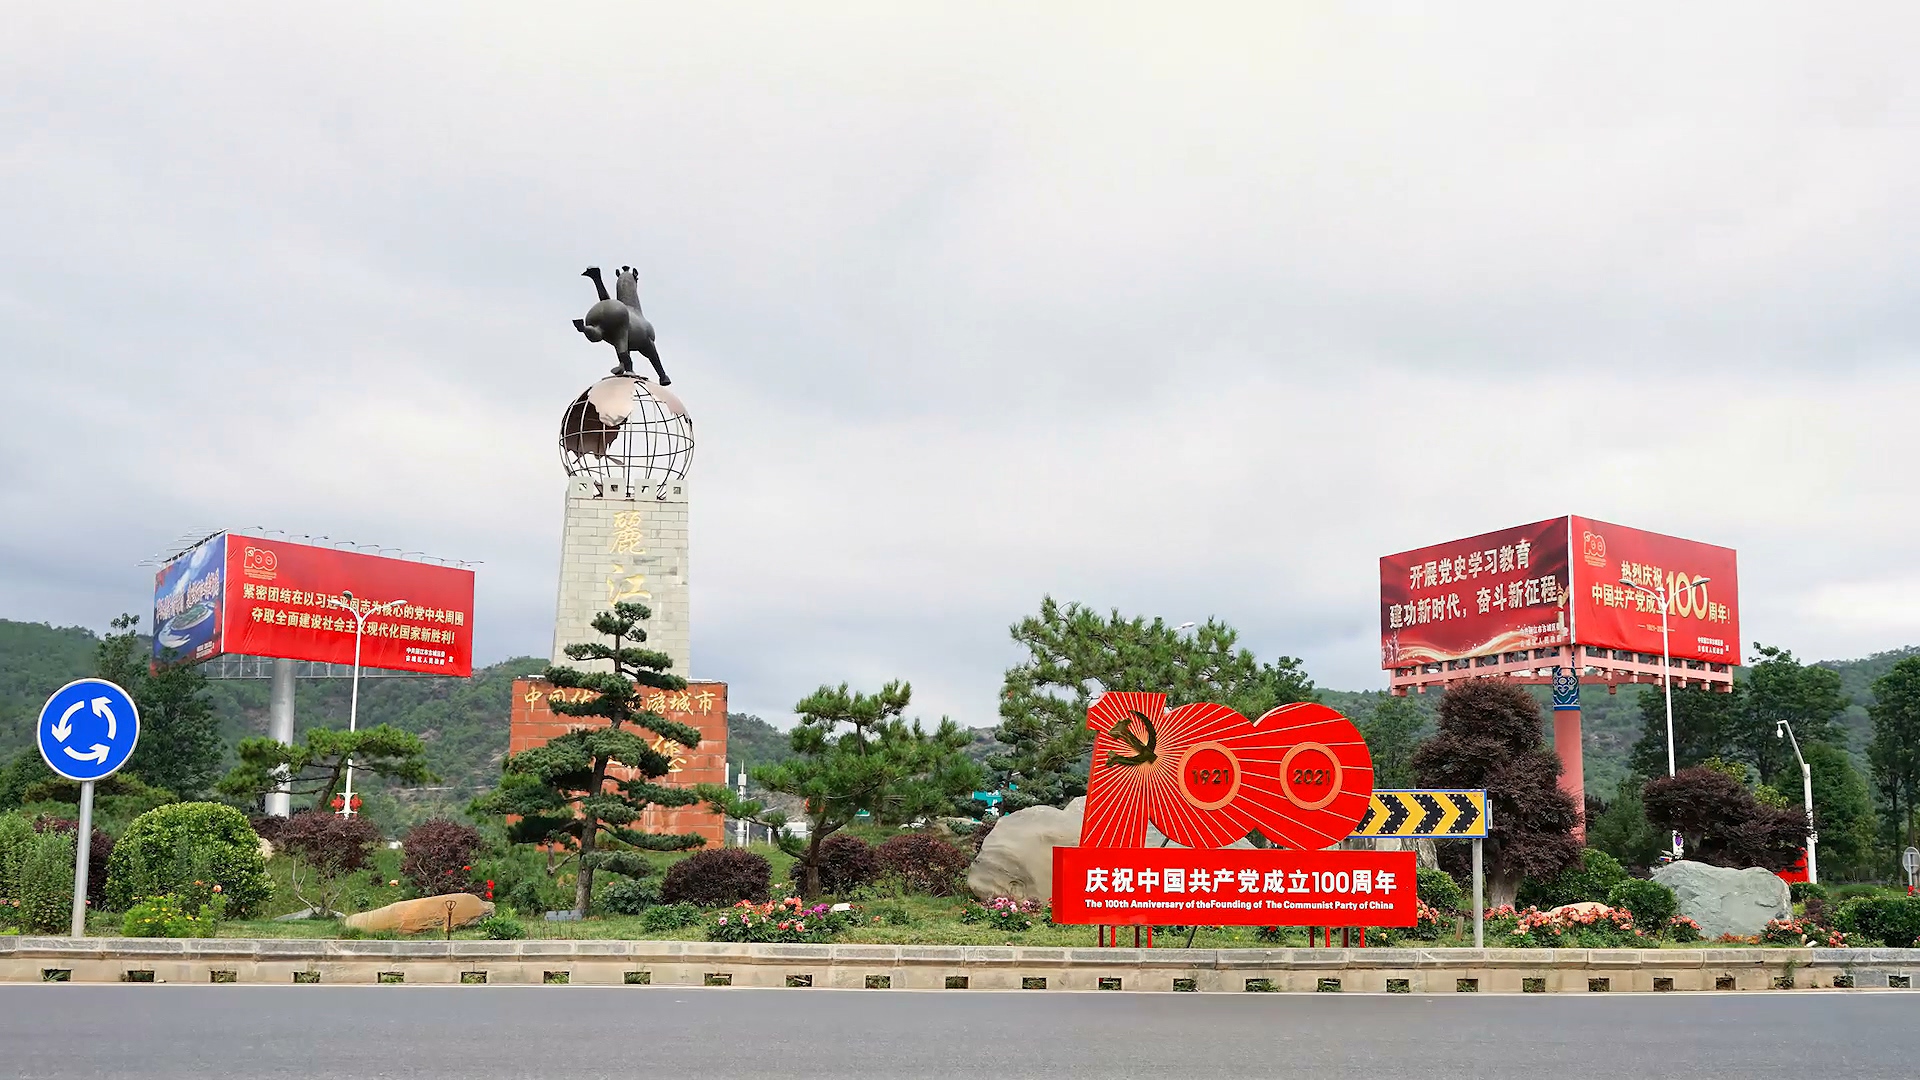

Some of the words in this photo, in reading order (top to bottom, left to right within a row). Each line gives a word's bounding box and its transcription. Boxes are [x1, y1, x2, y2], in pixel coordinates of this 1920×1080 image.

[1409, 538, 1532, 591] 开展党史学习教育
[1621, 560, 1664, 588] 热烈庆祝
[242, 583, 464, 627] 紧密团结在以习近平同志为核心的党中央周围
[1389, 574, 1558, 629] 建功新时代，奋斗新征程
[1191, 769, 1229, 785] 1921
[1293, 769, 1331, 785] 2021
[1085, 867, 1397, 895] 庆祝中国共产党成立100周年
[1085, 899, 1102, 908] The
[1105, 899, 1129, 909] 100th
[1130, 899, 1184, 910] Anniversary
[1185, 899, 1195, 909] of
[1196, 899, 1251, 911] theFounding
[1253, 900, 1263, 909] of
[1266, 900, 1282, 909] The
[1283, 900, 1333, 909] Communist
[1334, 901, 1357, 911] Party
[1359, 901, 1369, 910] of
[1369, 901, 1394, 910] China
